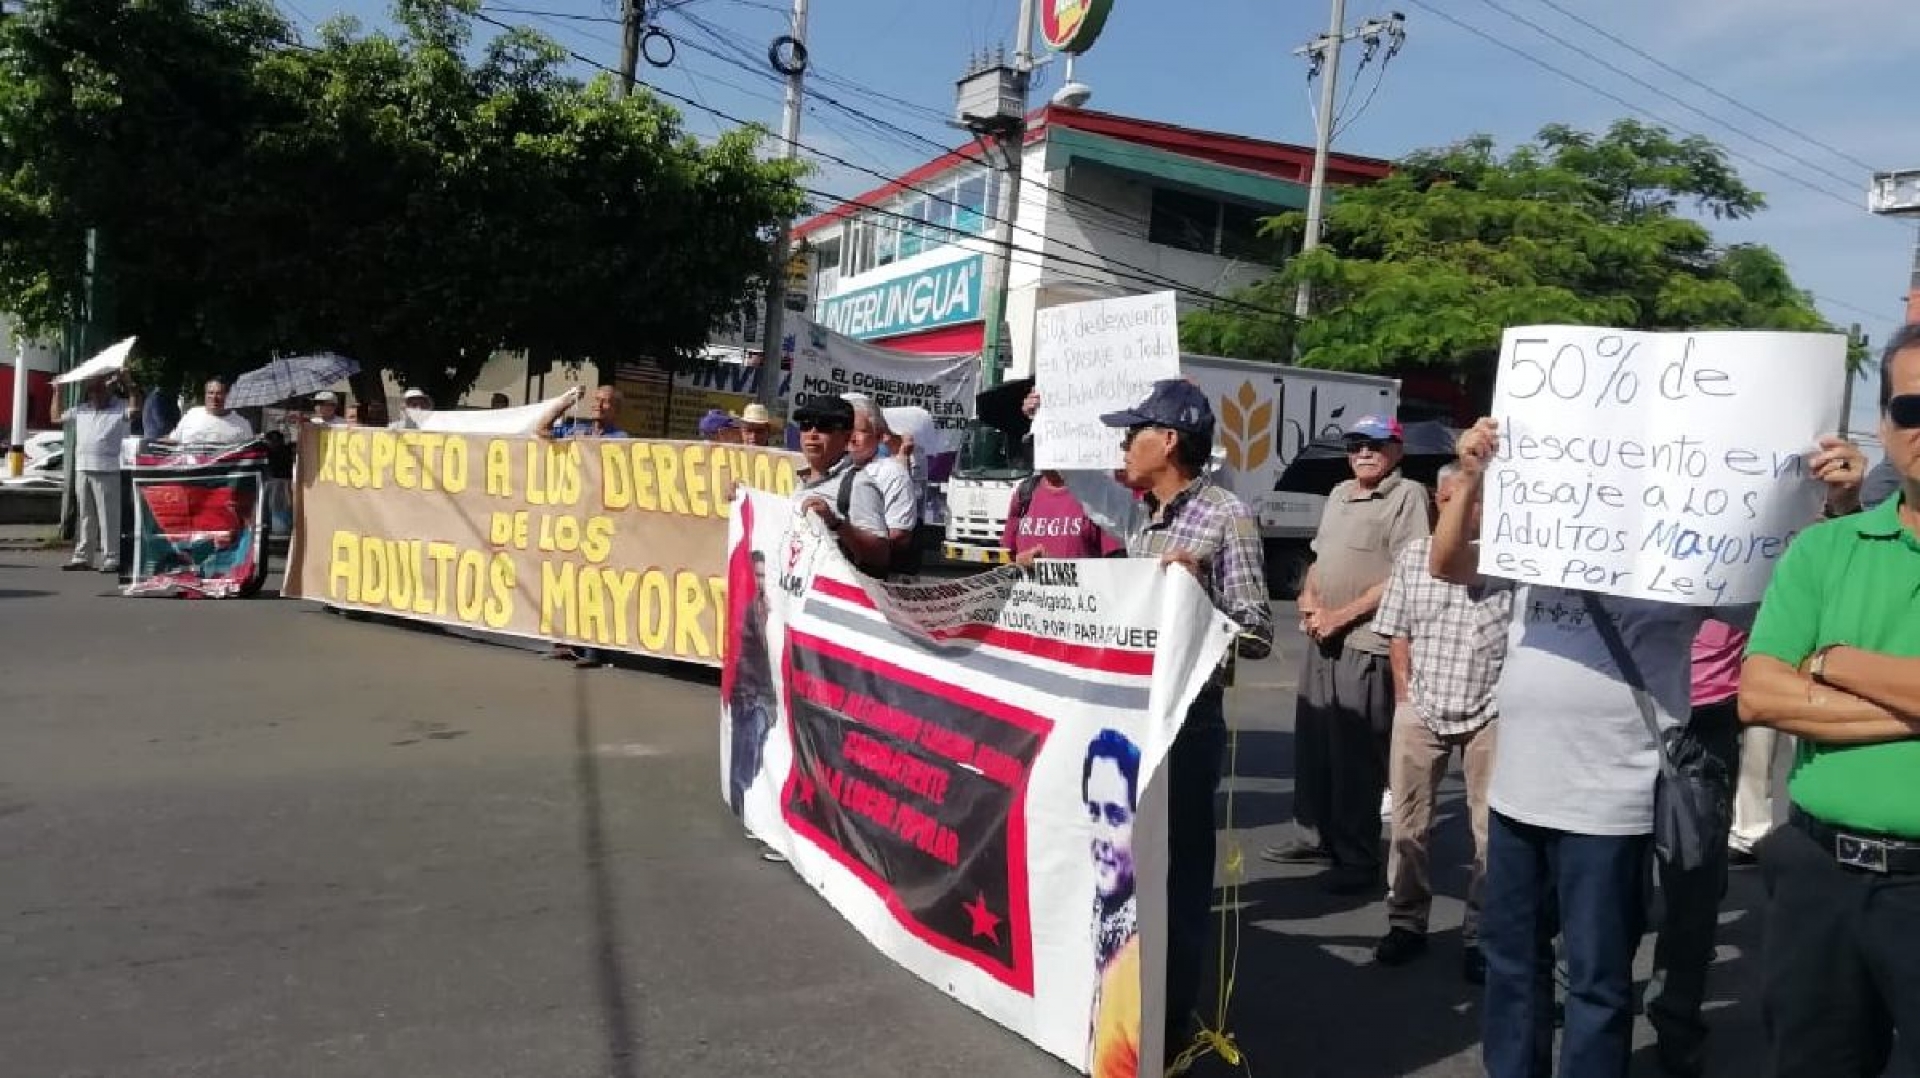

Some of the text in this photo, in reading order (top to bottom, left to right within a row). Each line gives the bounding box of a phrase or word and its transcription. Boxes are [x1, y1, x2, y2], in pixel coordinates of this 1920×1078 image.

[826, 263, 970, 336] INTERLINGUA
[832, 367, 849, 384] EL
[852, 372, 924, 397] GOBIERNO
[1508, 336, 1736, 408] 50% de
[319, 430, 467, 494] RESPETO
[487, 438, 513, 497] A
[525, 436, 582, 505] LOS
[1497, 416, 1802, 479] descuento en
[1499, 470, 1625, 518] Pasaje
[1643, 486, 1670, 508] a
[490, 511, 616, 563] DE LOS
[1020, 516, 1082, 537] REGIS
[329, 530, 516, 628] ADULTOS
[1496, 553, 1542, 577] es
